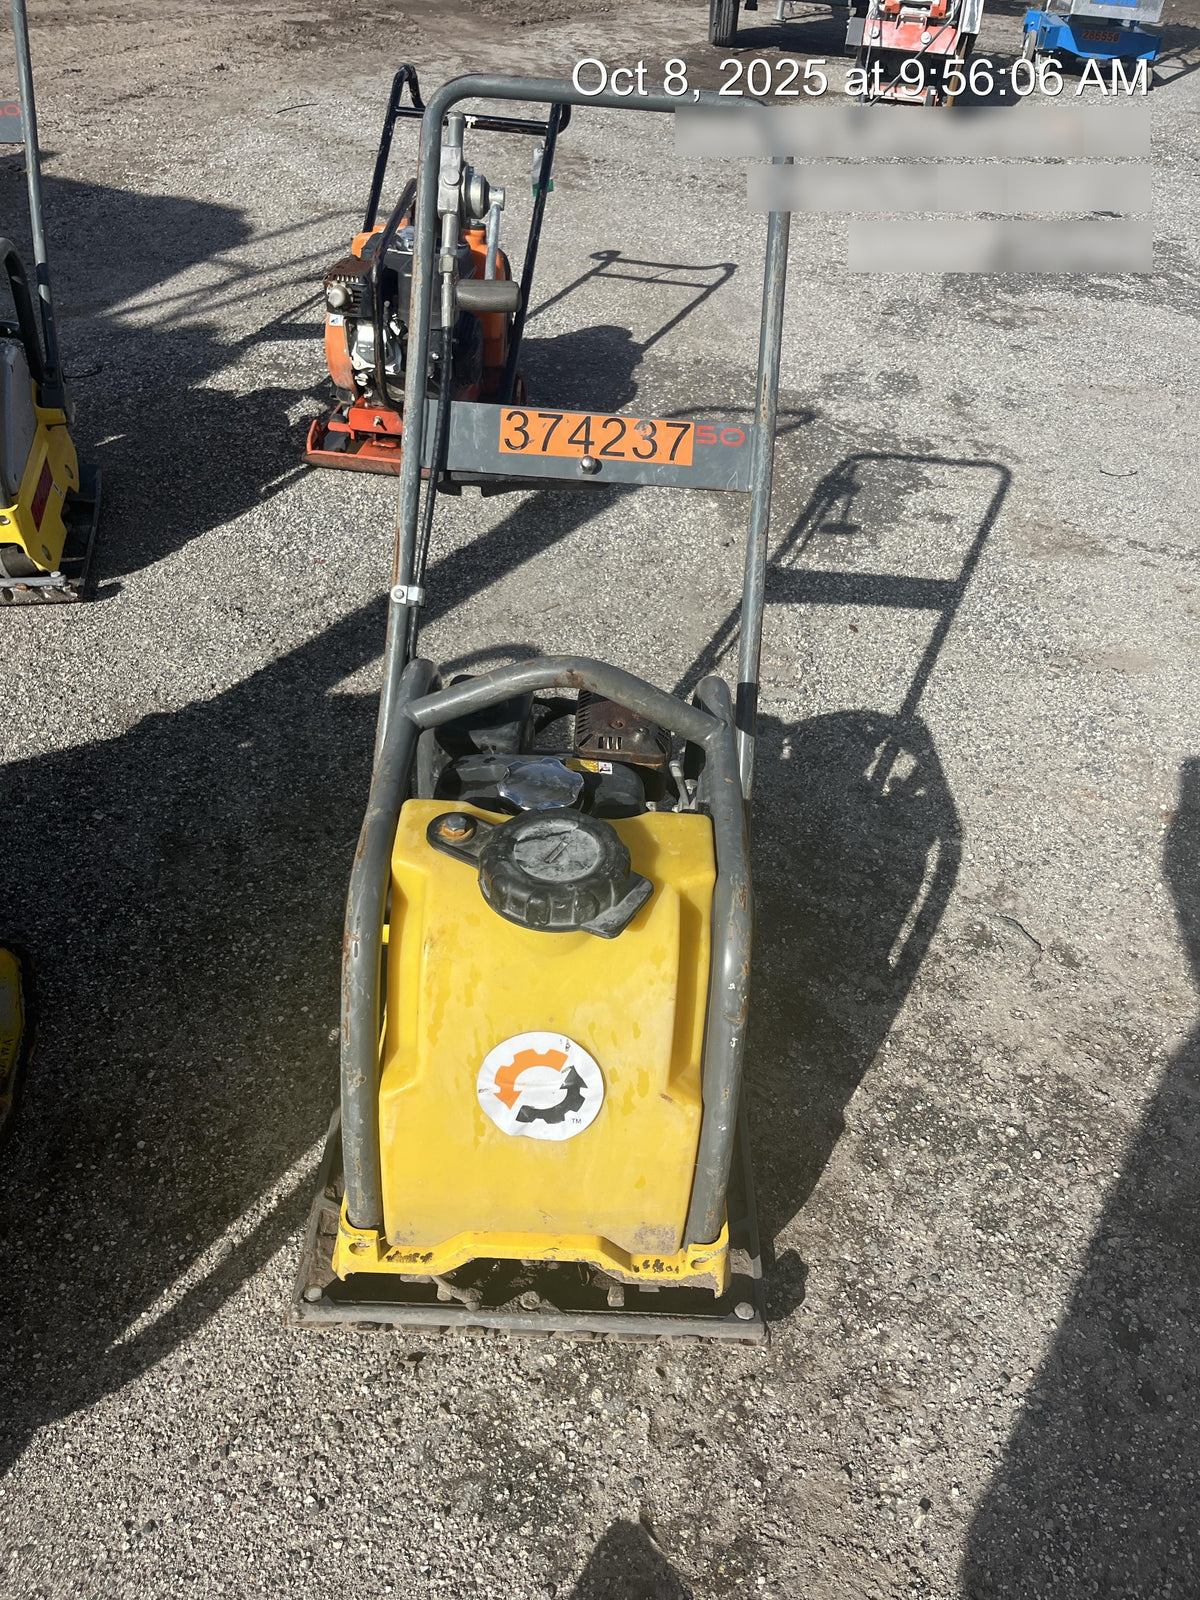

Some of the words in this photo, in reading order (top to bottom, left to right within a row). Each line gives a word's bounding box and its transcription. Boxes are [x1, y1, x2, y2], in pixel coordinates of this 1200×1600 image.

[0, 104, 21, 117] 0
[503, 410, 692, 462] 374237
[695, 425, 746, 447] 50
